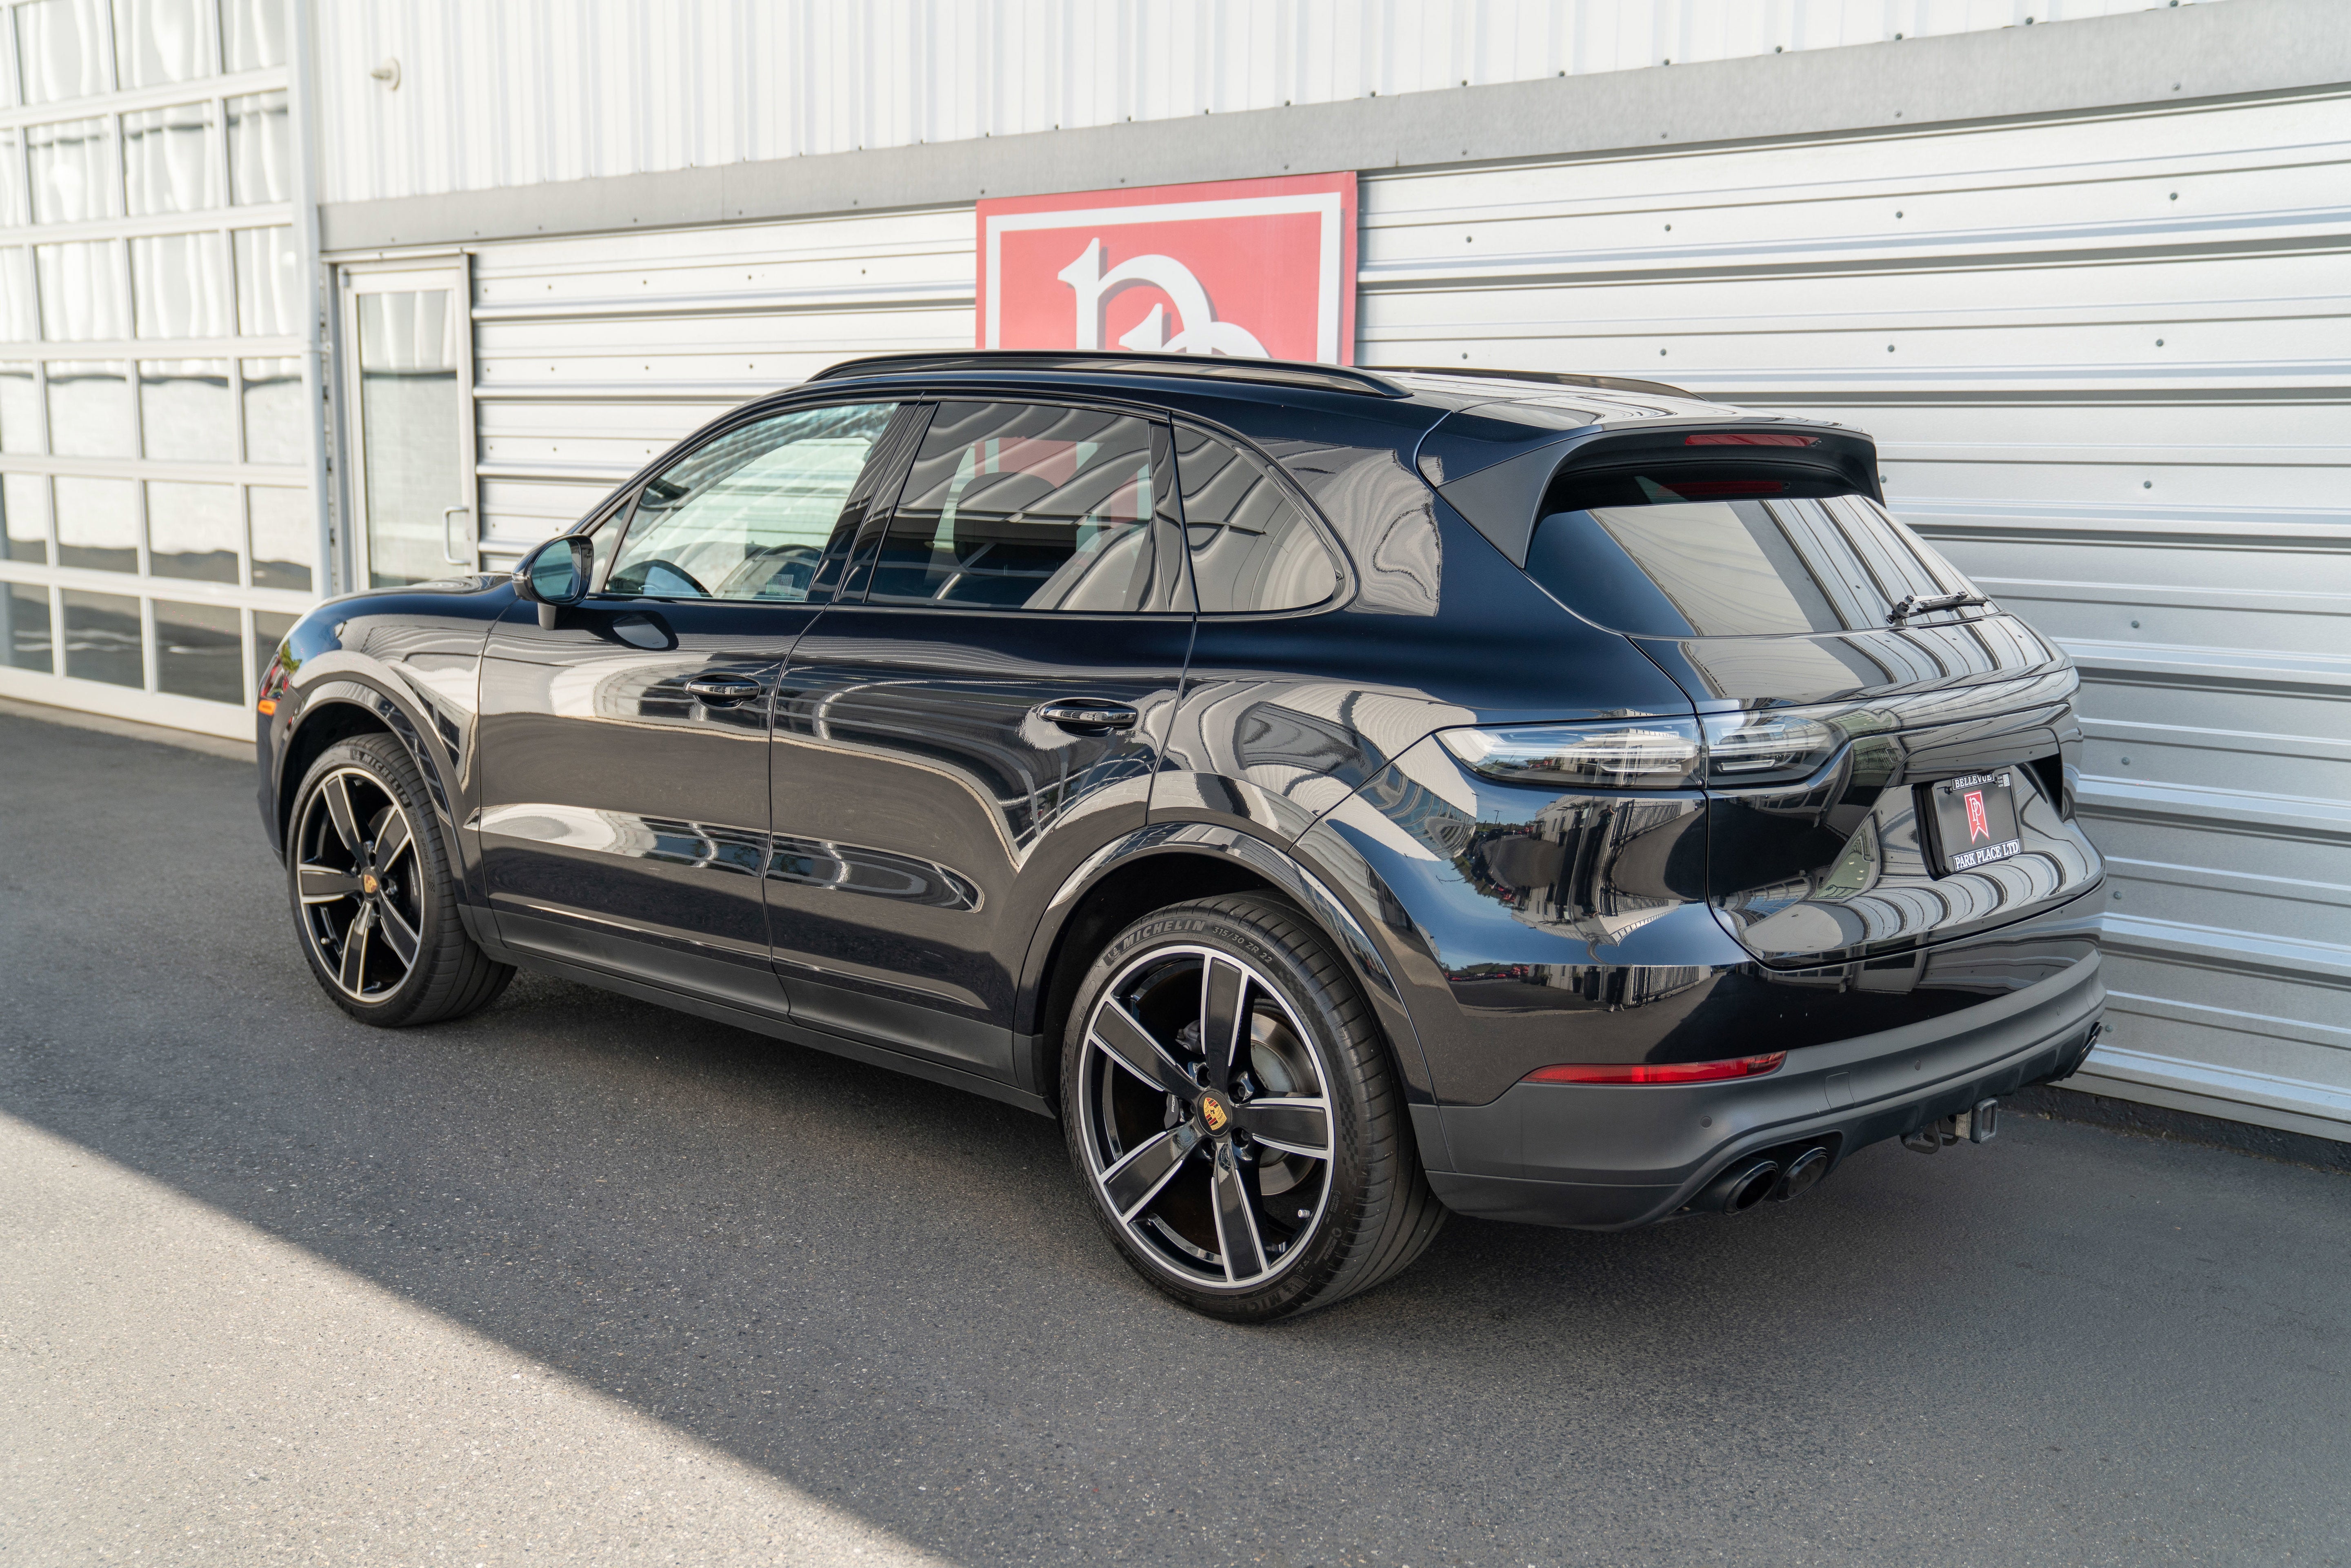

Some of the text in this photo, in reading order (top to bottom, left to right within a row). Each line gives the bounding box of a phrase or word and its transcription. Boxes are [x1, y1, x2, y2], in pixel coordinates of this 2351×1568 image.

[362, 754, 409, 804] MICHELIN
[1955, 774, 1992, 788] BELLEVUE
[411, 813, 422, 834] PILOT
[420, 838, 430, 865] SPORT
[1955, 841, 2018, 870] PARK PLACE LTD
[1123, 919, 1205, 950] MICHELIN
[1213, 927, 1272, 963] 315/30 ZR 22
[1323, 1238, 1338, 1261] MICHELIN
